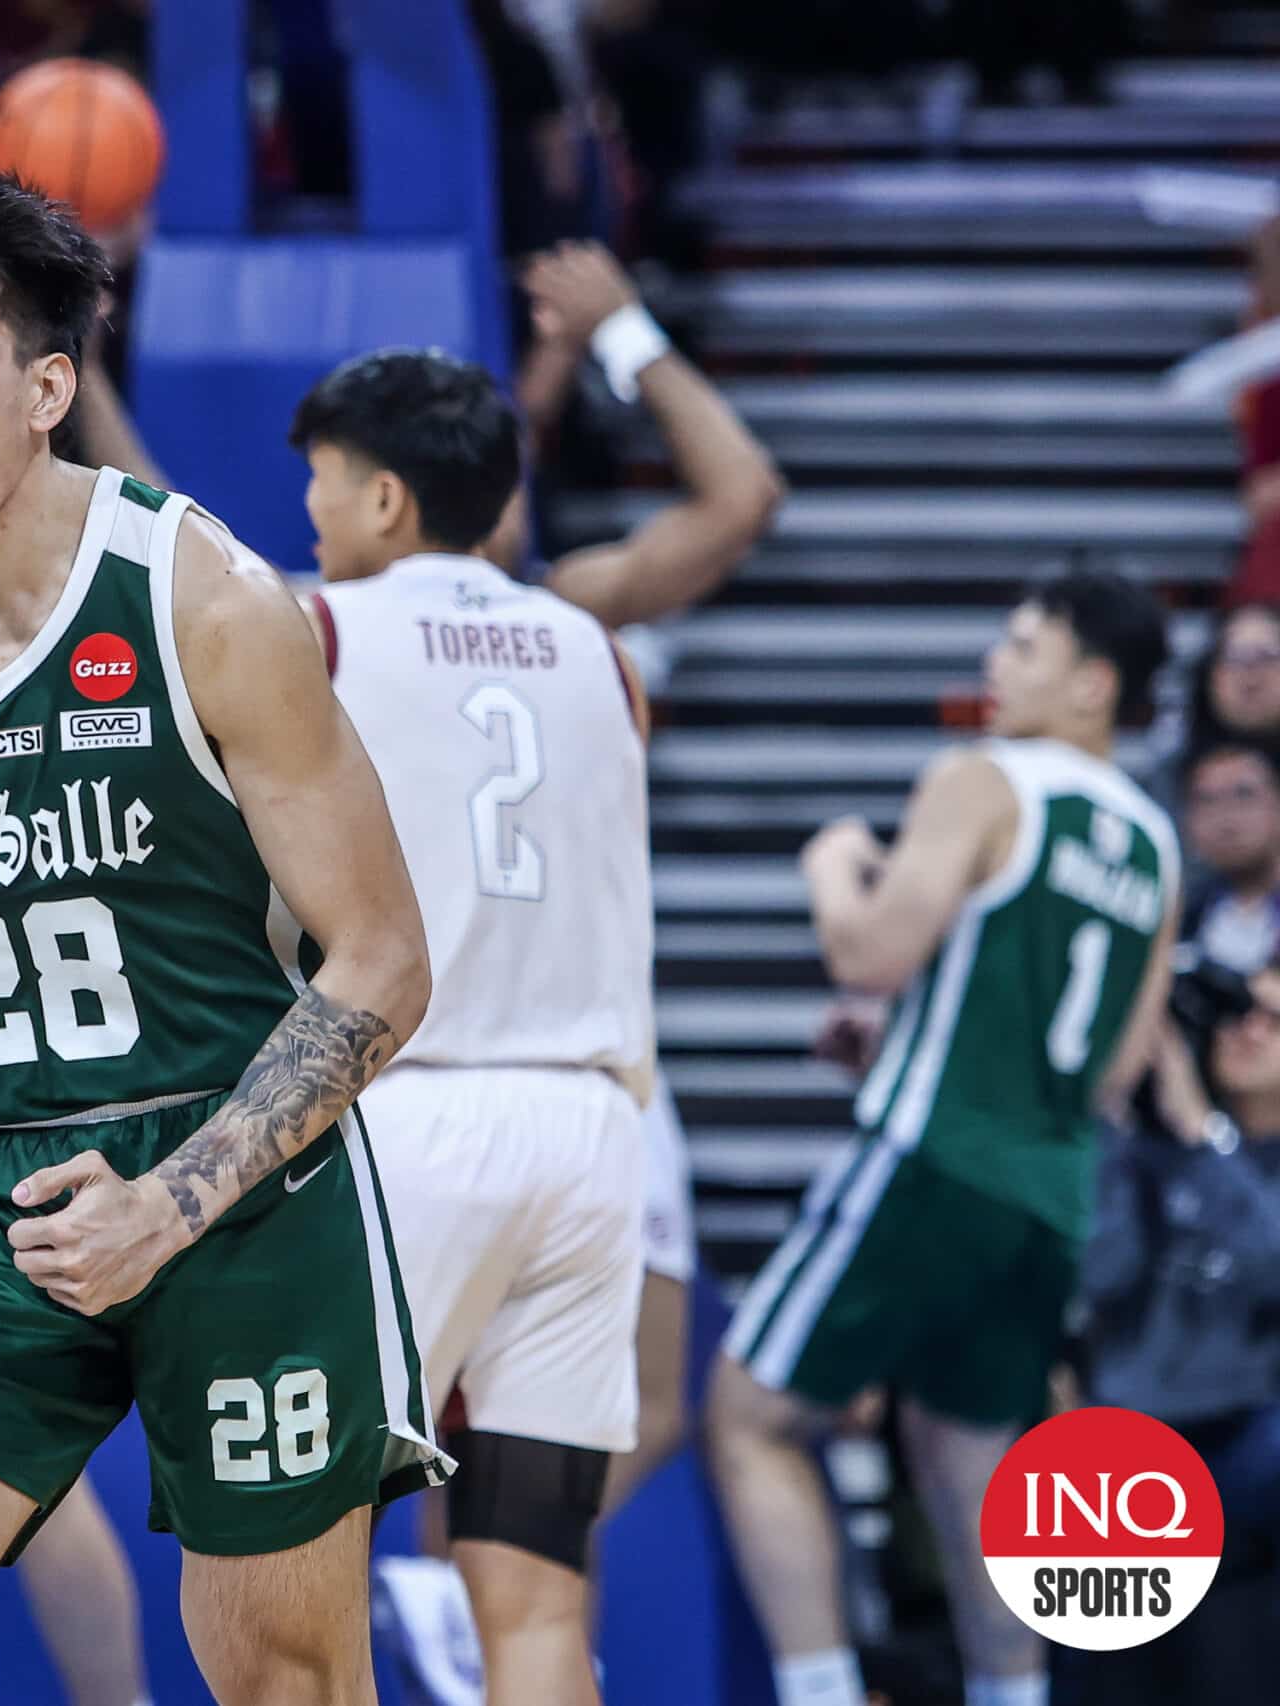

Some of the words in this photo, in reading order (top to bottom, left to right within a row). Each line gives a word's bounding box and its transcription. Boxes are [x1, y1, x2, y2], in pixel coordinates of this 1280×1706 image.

[75, 659, 132, 677] Gazz
[417, 617, 559, 669] TORRES
[77, 717, 134, 732] CWC
[457, 677, 547, 903] 2
[1046, 918, 1112, 1075] 1
[207, 1368, 330, 1482] 28
